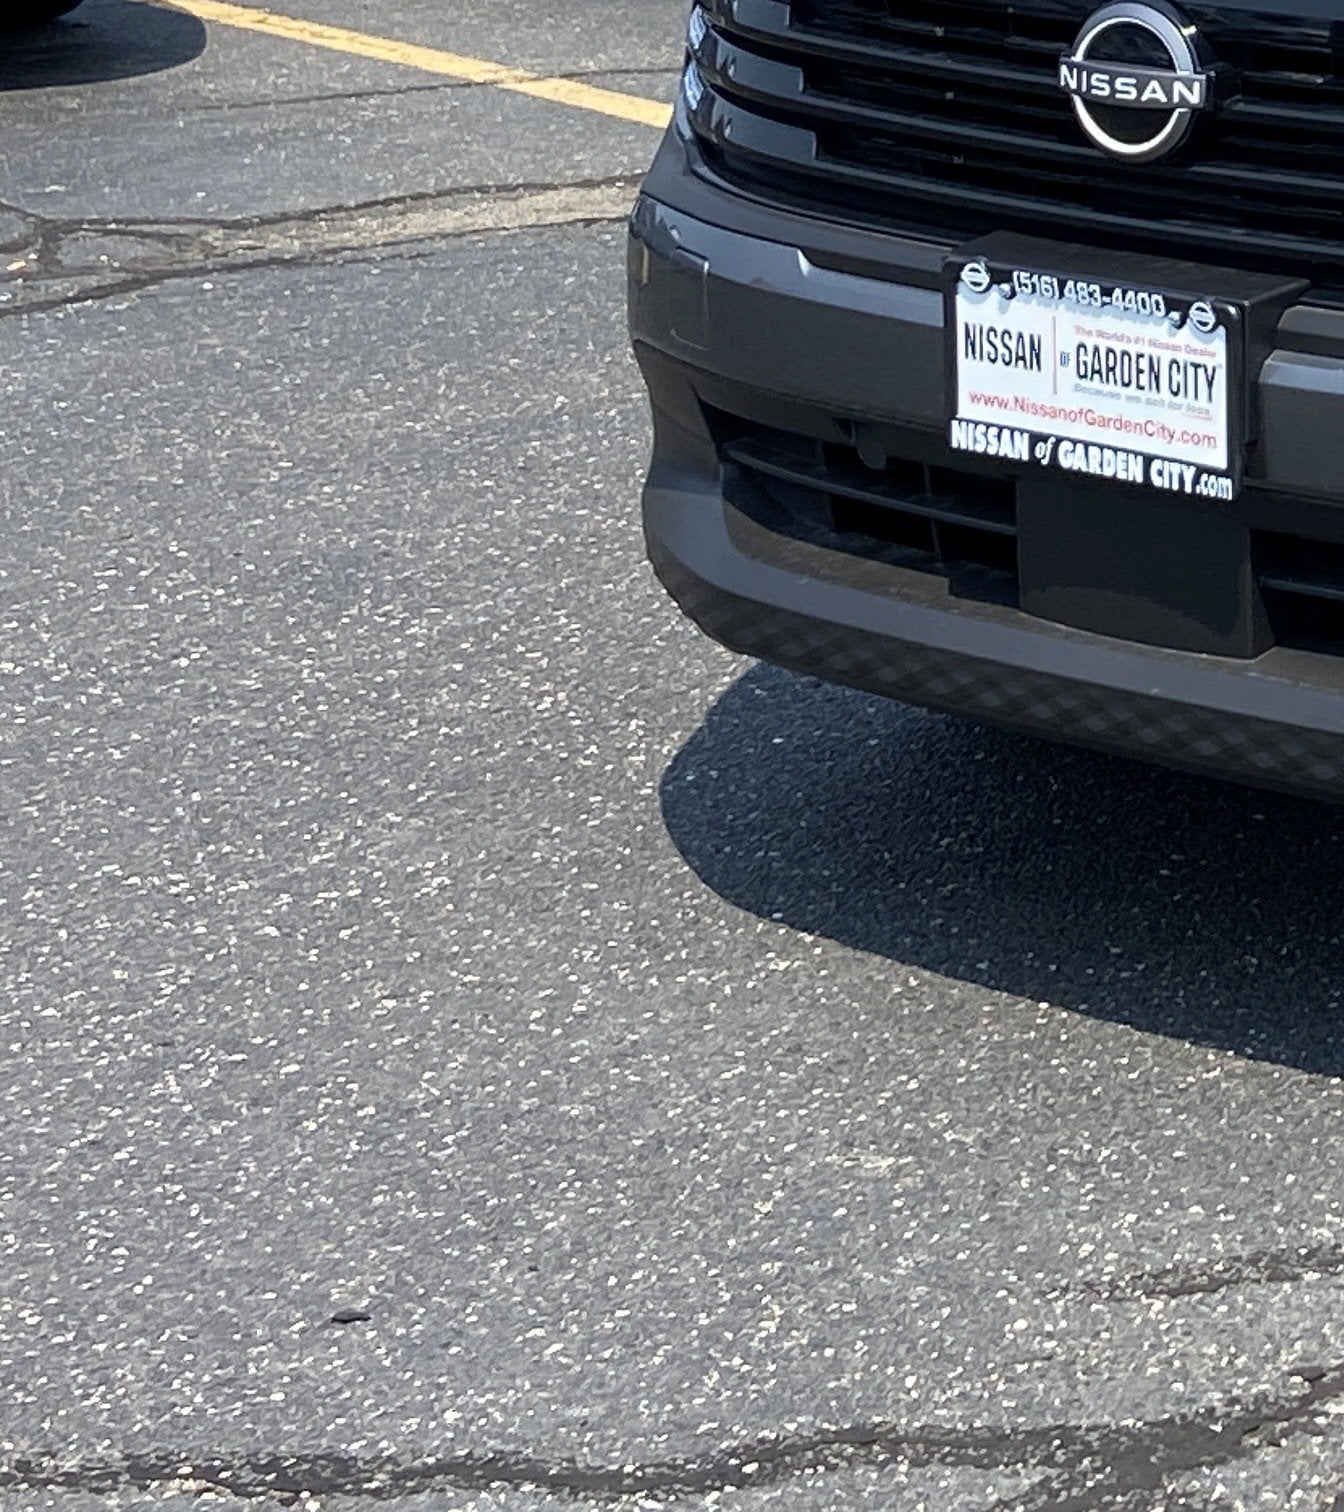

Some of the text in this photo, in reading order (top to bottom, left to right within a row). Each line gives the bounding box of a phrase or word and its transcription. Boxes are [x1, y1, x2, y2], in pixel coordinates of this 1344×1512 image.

[1059, 64, 1201, 104] NISSAN
[1013, 271, 1166, 318] (516) 483-4400
[964, 322, 1042, 372] NISSAN
[1076, 342, 1161, 393] GARDEN
[1168, 358, 1218, 403] CITY
[968, 391, 1218, 449] www.NissanofGardenCity.com
[951, 420, 1233, 501] NISSAN of GARDEN CITY.com
